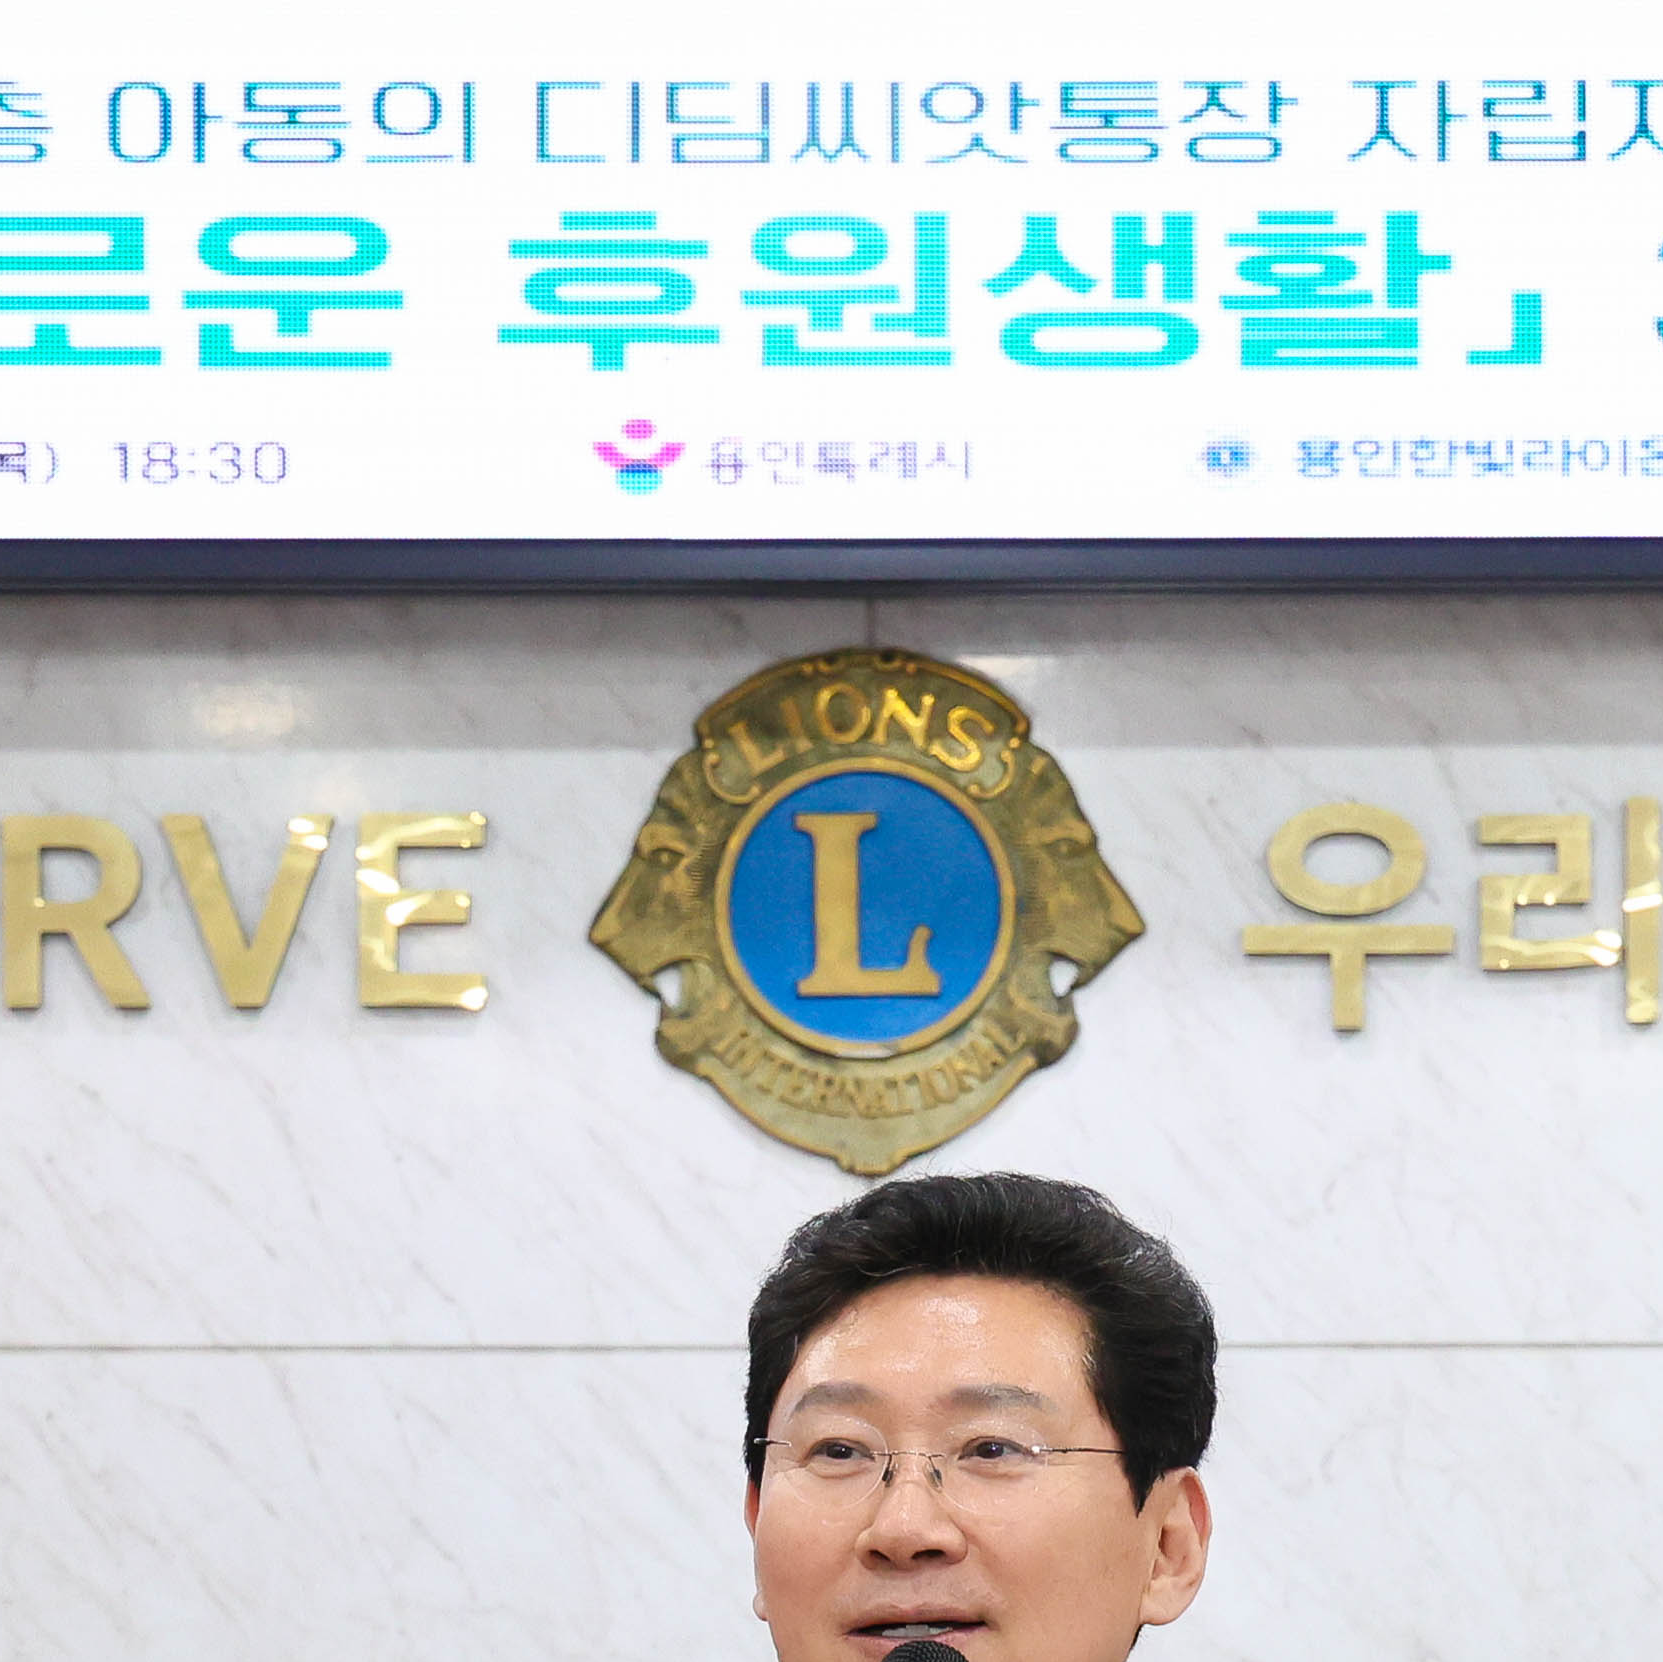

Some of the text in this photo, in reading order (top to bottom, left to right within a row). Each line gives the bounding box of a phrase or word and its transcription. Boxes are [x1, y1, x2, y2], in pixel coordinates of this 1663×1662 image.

[106, 80, 477, 168] 아동의
[535, 80, 1299, 168] 디딤씨앗통장
[496, 208, 1548, 373] 후원생활」
[114, 441, 290, 484] 18:30
[728, 682, 994, 774] LIONS
[793, 810, 941, 998] L
